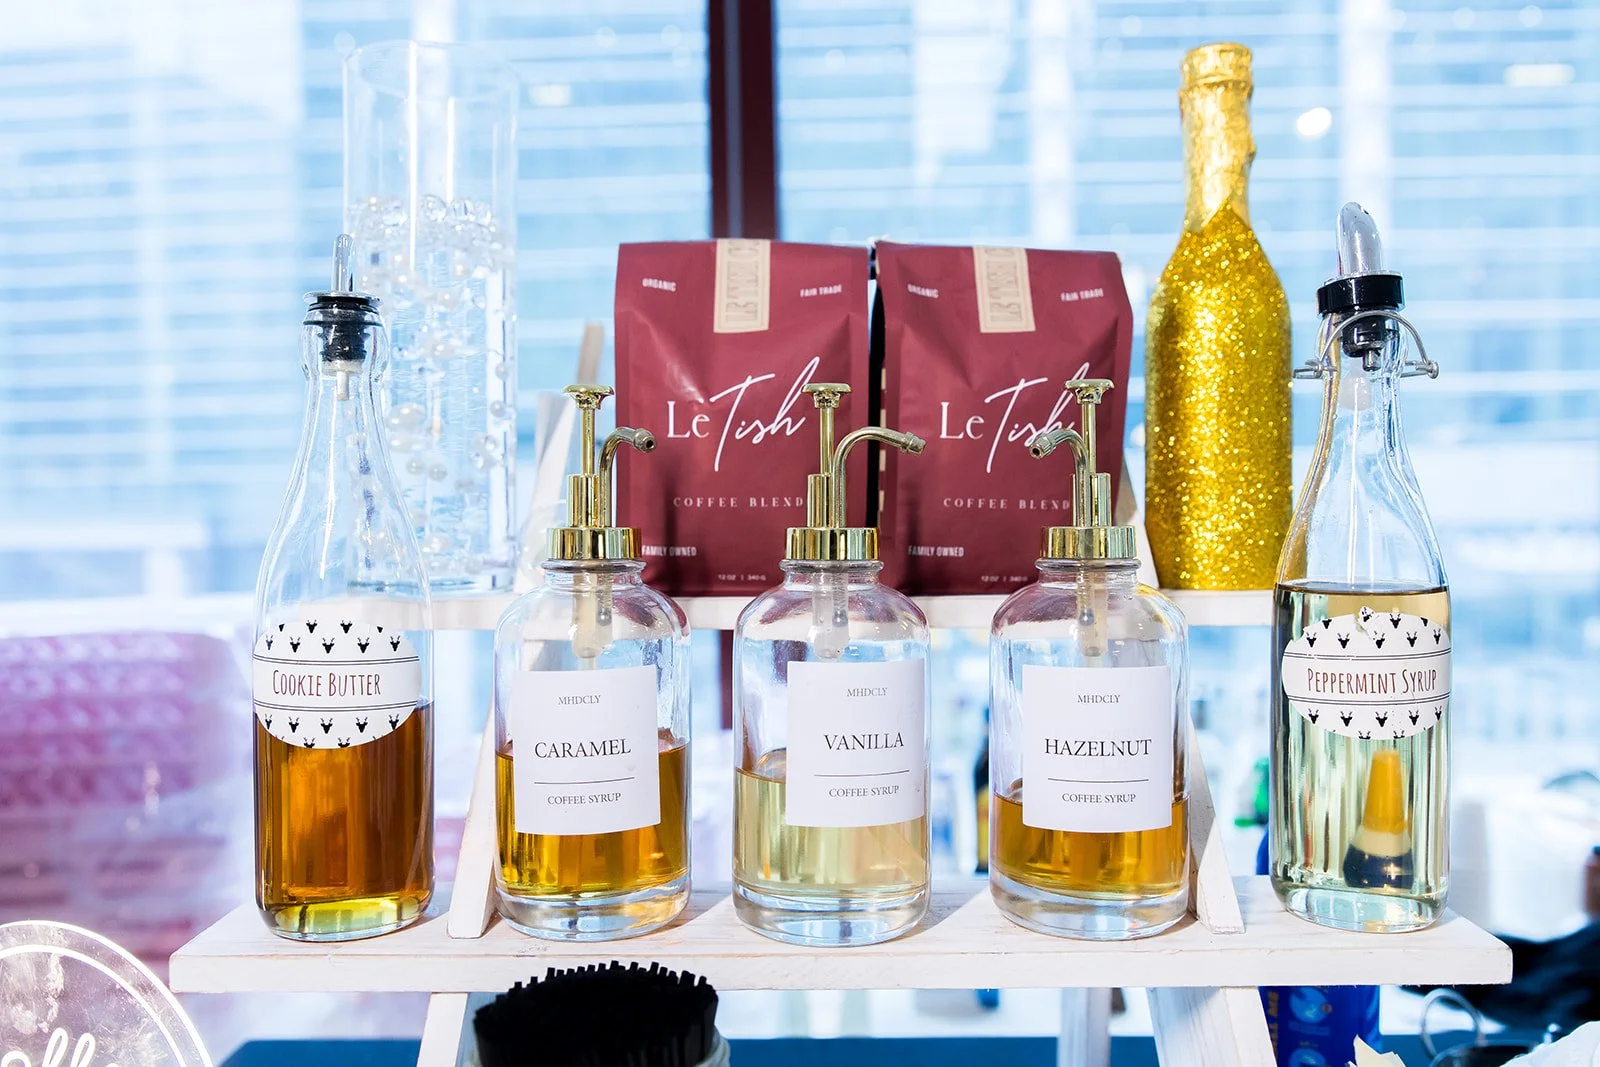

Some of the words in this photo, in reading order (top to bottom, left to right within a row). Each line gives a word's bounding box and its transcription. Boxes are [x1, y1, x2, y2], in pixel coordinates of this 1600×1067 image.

[642, 278, 676, 292] ORGANIC
[800, 288, 817, 297] FAIR
[819, 284, 842, 296] TRADE
[907, 284, 939, 298] ORGANIC
[1061, 292, 1078, 301] FAIR
[1080, 288, 1104, 299] TRADE
[666, 400, 710, 439] Le
[709, 356, 820, 472] Tish
[939, 401, 985, 440] Le
[673, 496, 738, 508] COFFEE
[749, 496, 804, 508] BLEND
[943, 497, 1008, 509] COFFEE
[1019, 498, 1070, 510] BLEND
[641, 544, 667, 556] FAMILY
[669, 546, 697, 557] OWNED
[908, 545, 935, 556] FAMILY
[936, 546, 964, 557] OWNED
[272, 669, 322, 697] COOKIE
[328, 672, 382, 697] BUTTER
[1307, 668, 1396, 695] PEPPERMINT
[1401, 668, 1437, 693] SYRUP
[846, 687, 888, 698] MHDCLY
[1077, 694, 1121, 704] MHDCLY
[557, 694, 602, 706] MHDCLY
[823, 732, 905, 751] VANILLA
[1044, 738, 1152, 757] HAZELNUT
[534, 738, 632, 759] CARAMEL
[828, 788, 869, 798] COFFEE
[870, 785, 900, 797] SYRUP
[1061, 792, 1102, 804] COFFEE
[1104, 793, 1137, 804] SYRUP
[547, 795, 586, 805] COFFEE
[588, 792, 622, 805] SYRUP
